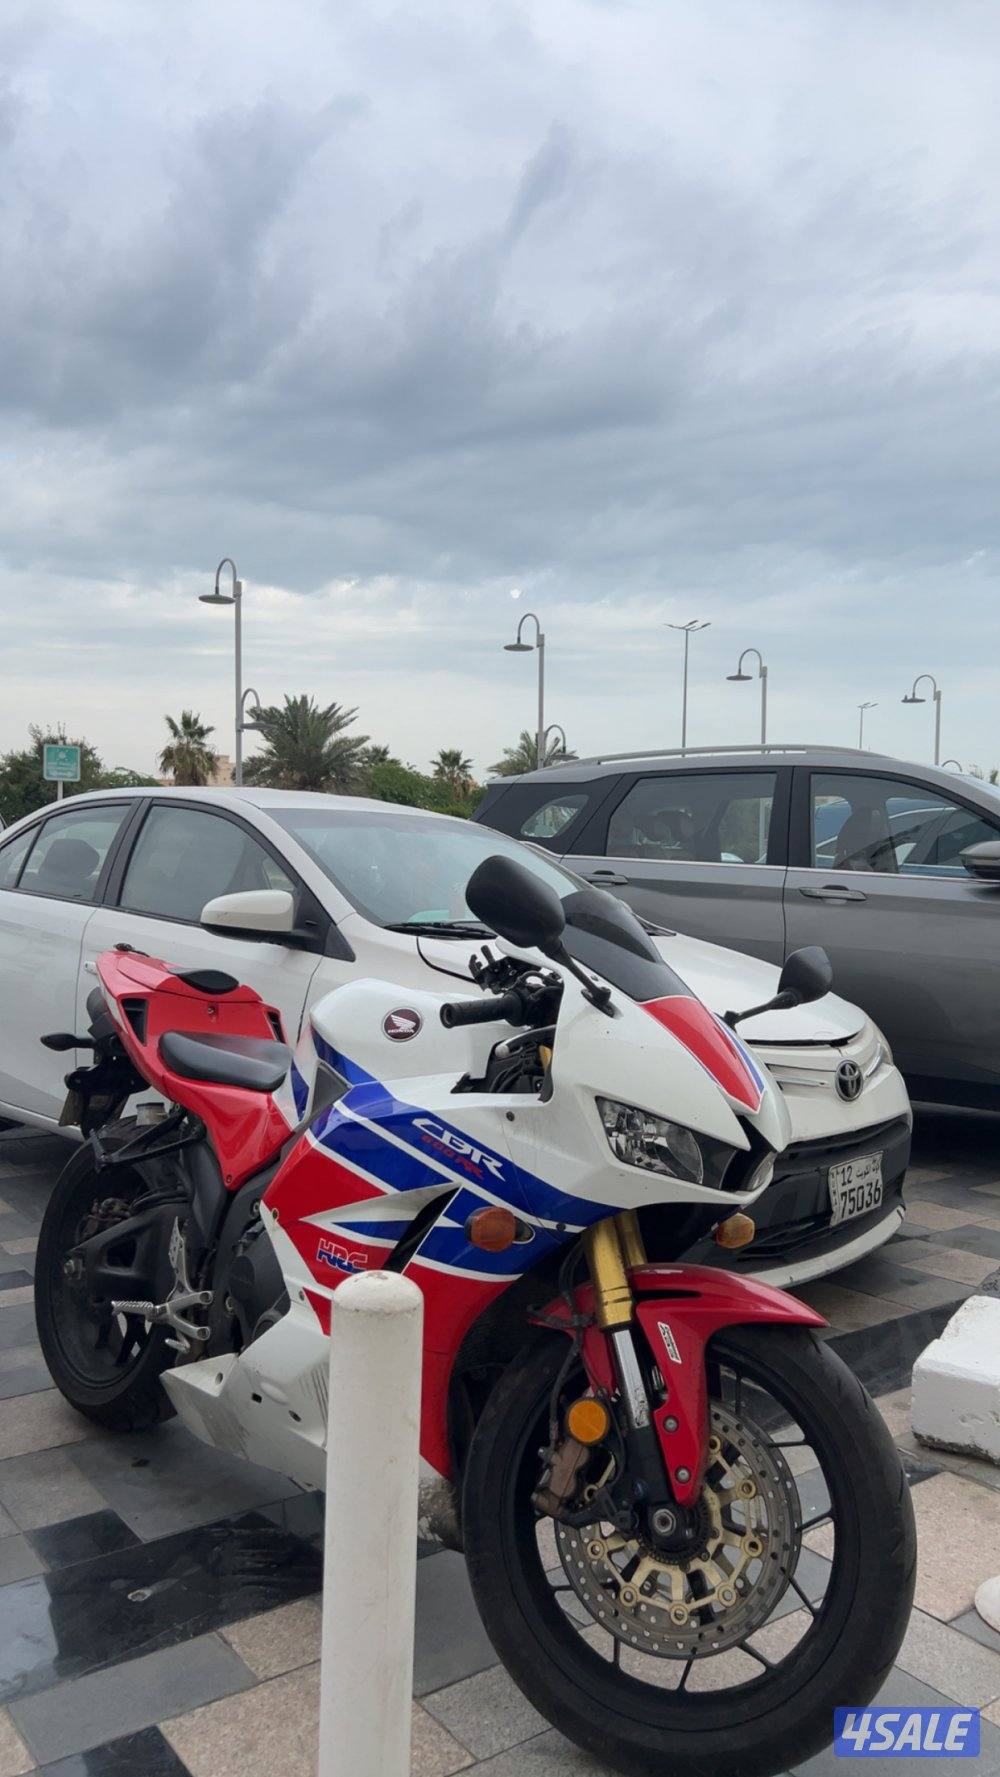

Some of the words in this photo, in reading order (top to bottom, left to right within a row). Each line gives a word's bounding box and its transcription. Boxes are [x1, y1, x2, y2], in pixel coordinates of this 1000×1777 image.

[412, 1118, 506, 1182] CBR
[841, 1165, 853, 1187] 12
[841, 1179, 881, 1219] 75036
[316, 1237, 368, 1274] HRC
